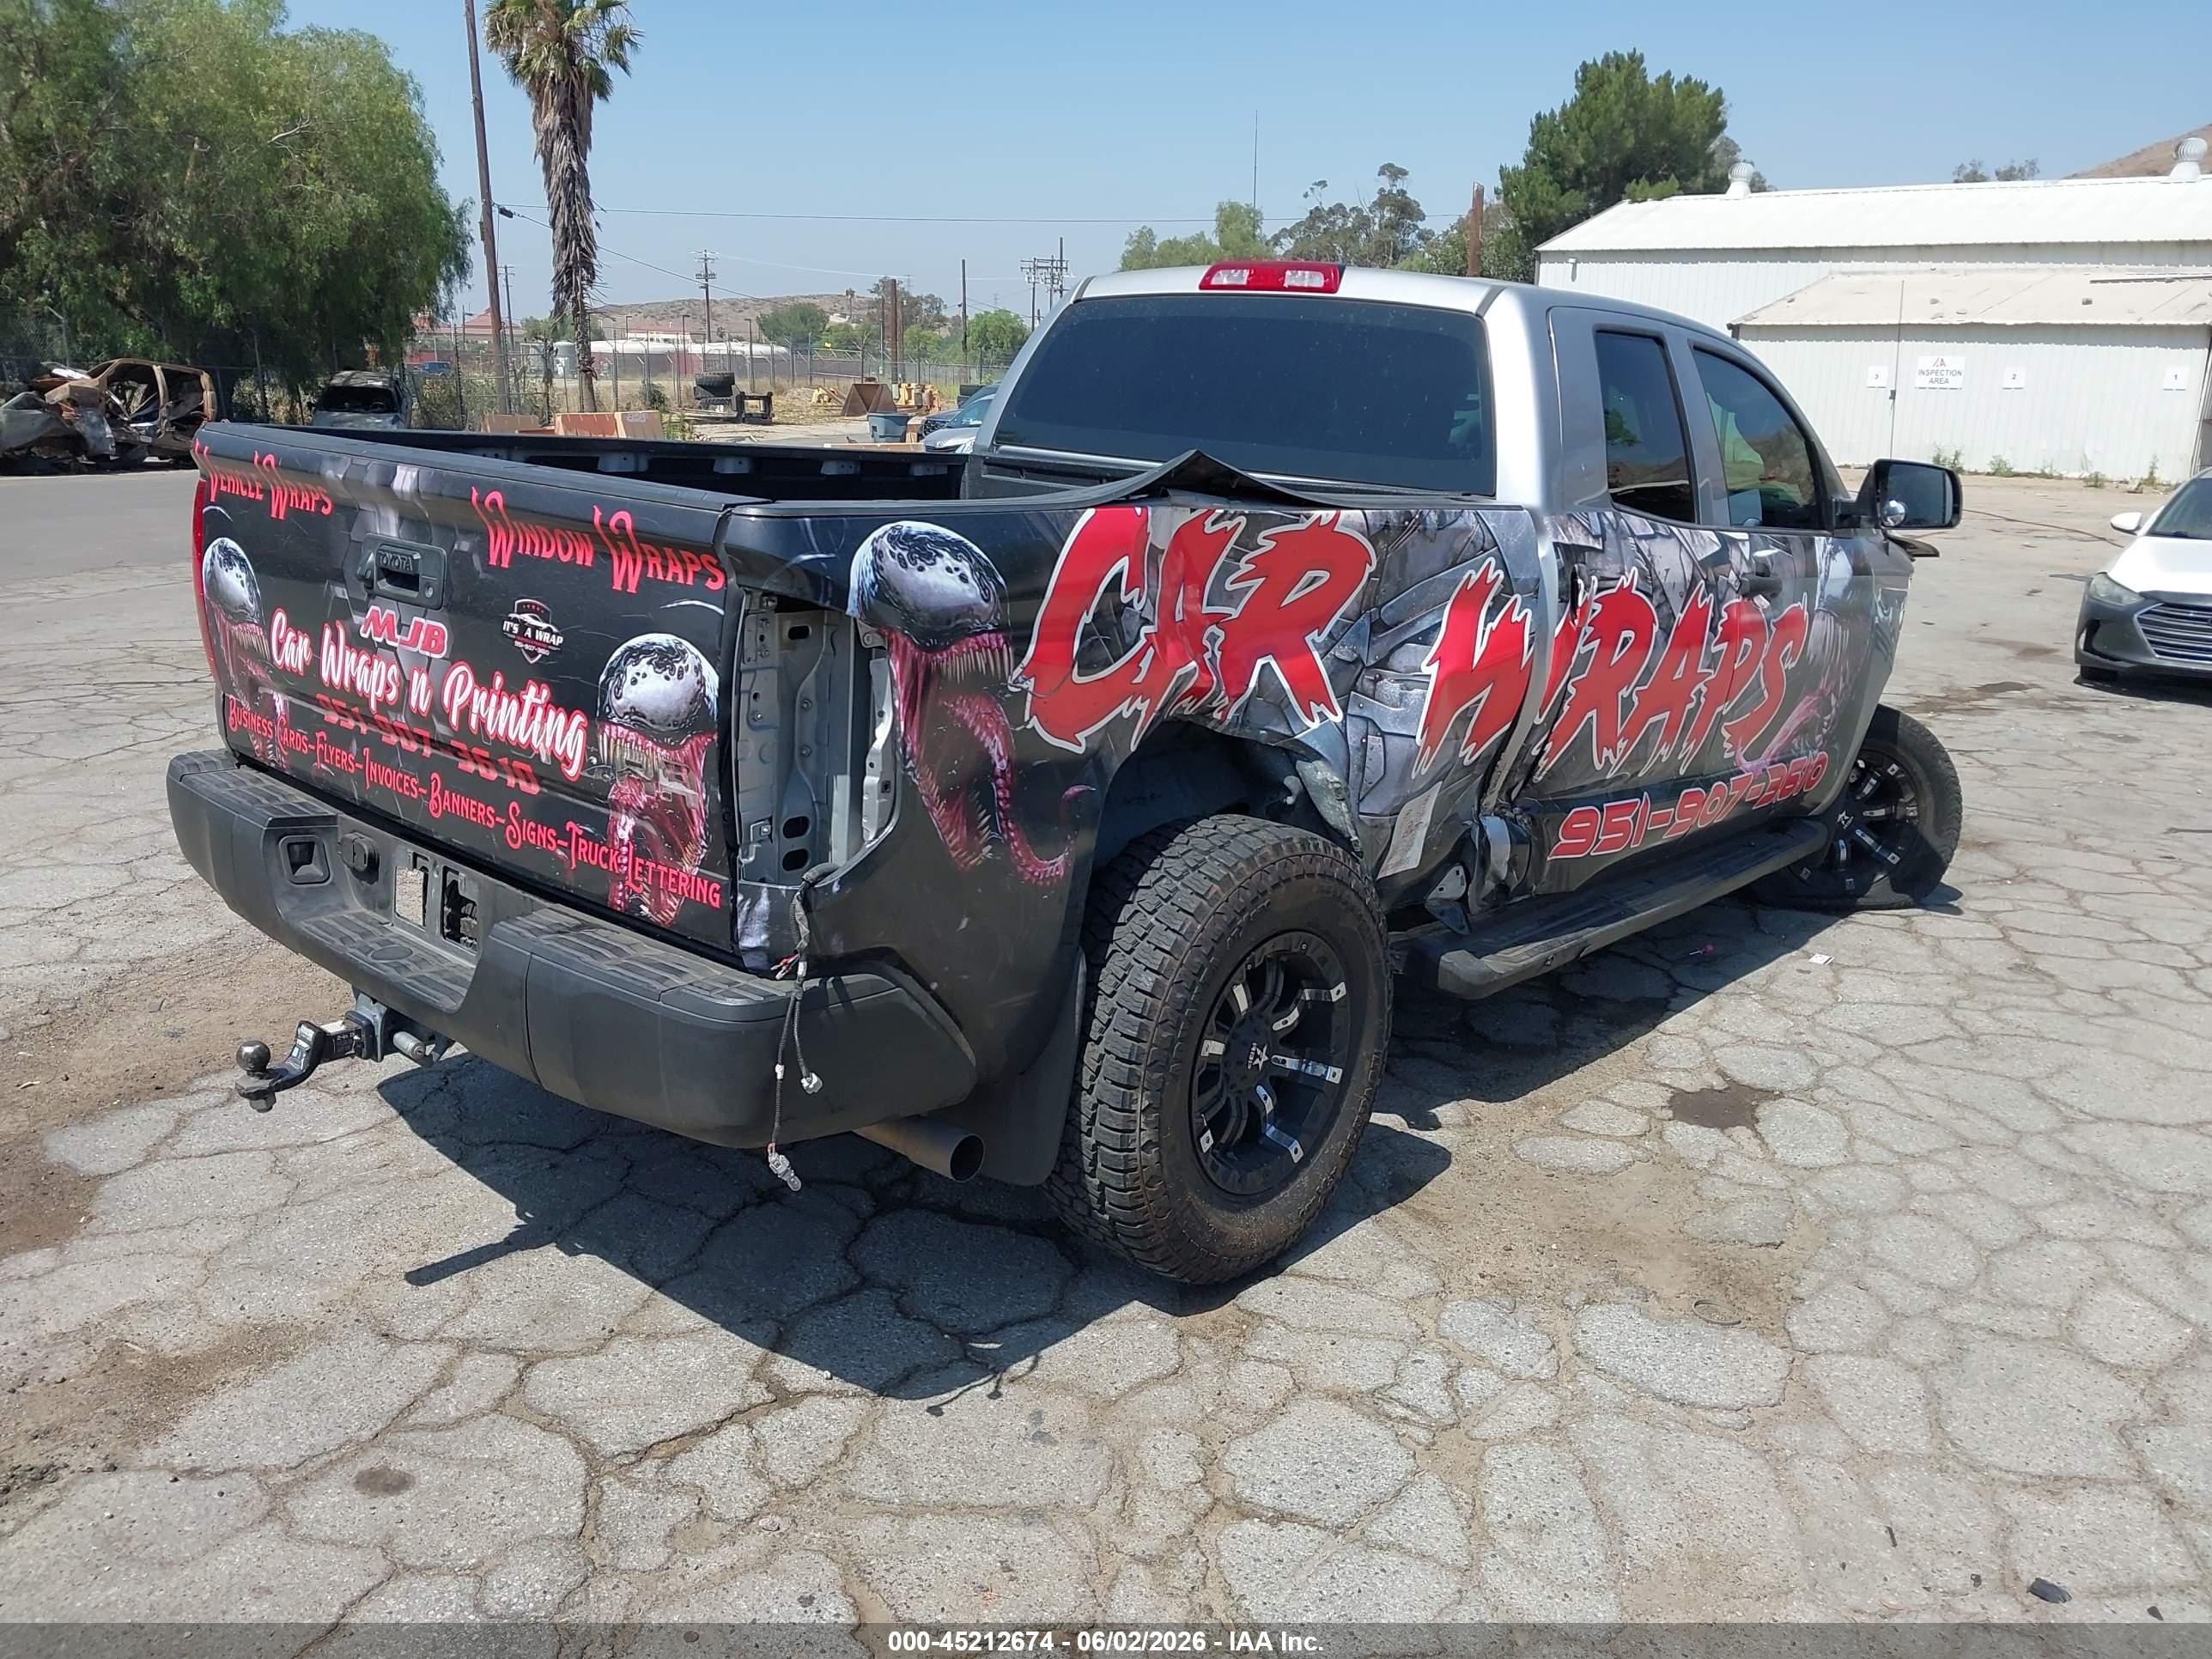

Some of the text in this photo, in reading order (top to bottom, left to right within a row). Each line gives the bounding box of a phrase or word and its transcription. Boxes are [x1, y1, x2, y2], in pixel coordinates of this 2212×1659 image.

[378, 550, 413, 571] TOYOTA
[360, 605, 447, 659] MJB
[502, 620, 520, 634] IT'S
[524, 627, 532, 638] A
[535, 629, 563, 646] WRAP
[1007, 506, 1808, 782] CAR WRAPS
[270, 607, 588, 781] Car Wraps n Printing
[1547, 751, 1828, 860] 951-907-3610
